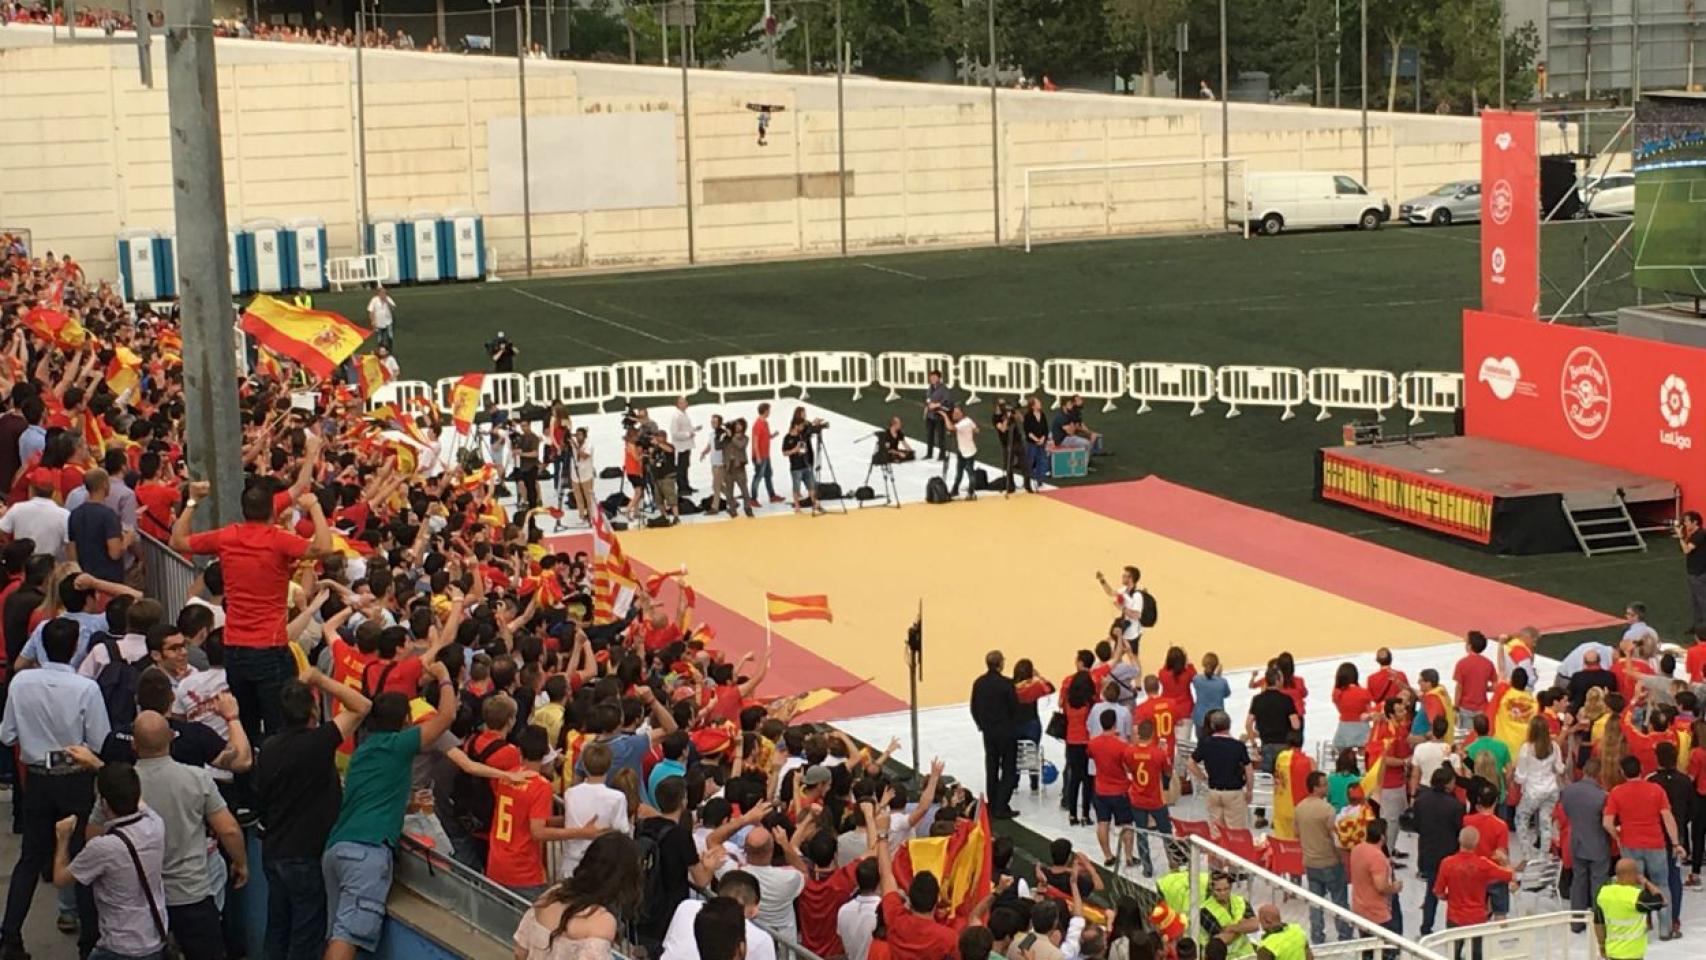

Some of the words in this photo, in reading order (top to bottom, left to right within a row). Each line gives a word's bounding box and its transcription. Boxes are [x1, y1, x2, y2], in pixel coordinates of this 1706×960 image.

[1660, 429, 1691, 450] LaLiga
[1154, 712, 1172, 737] 10
[1137, 761, 1149, 786] 6
[496, 794, 515, 843] 6
